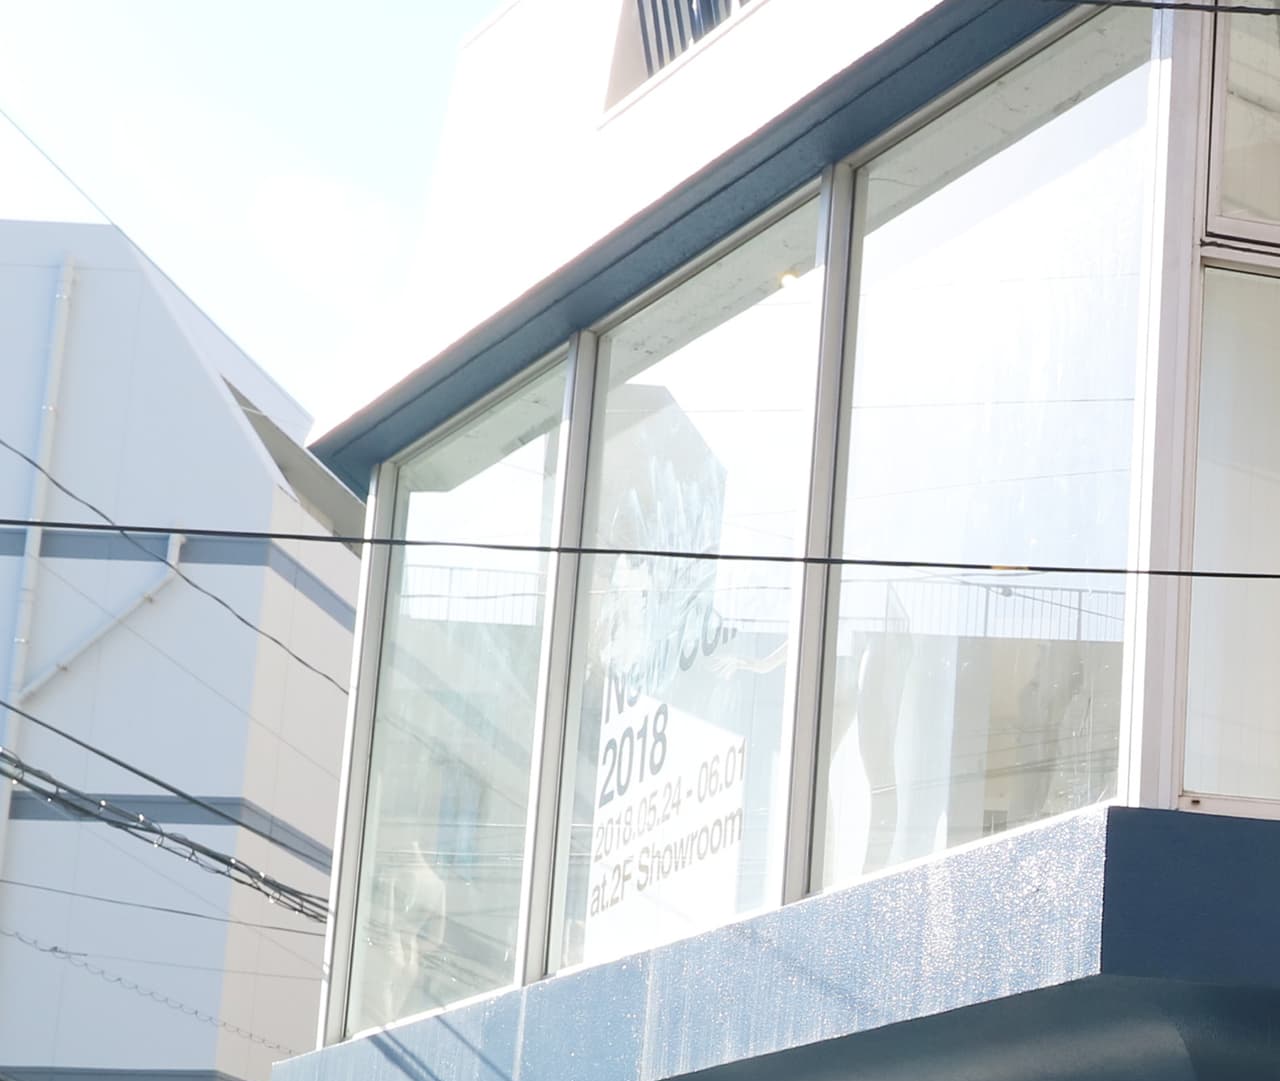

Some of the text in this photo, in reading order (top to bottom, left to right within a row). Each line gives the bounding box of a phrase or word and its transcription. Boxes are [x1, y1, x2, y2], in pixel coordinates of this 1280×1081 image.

[594, 776, 682, 862] 2018.05.24
[697, 738, 746, 806] 06.01
[597, 704, 669, 808] 2018
[637, 807, 744, 892] Showroom
